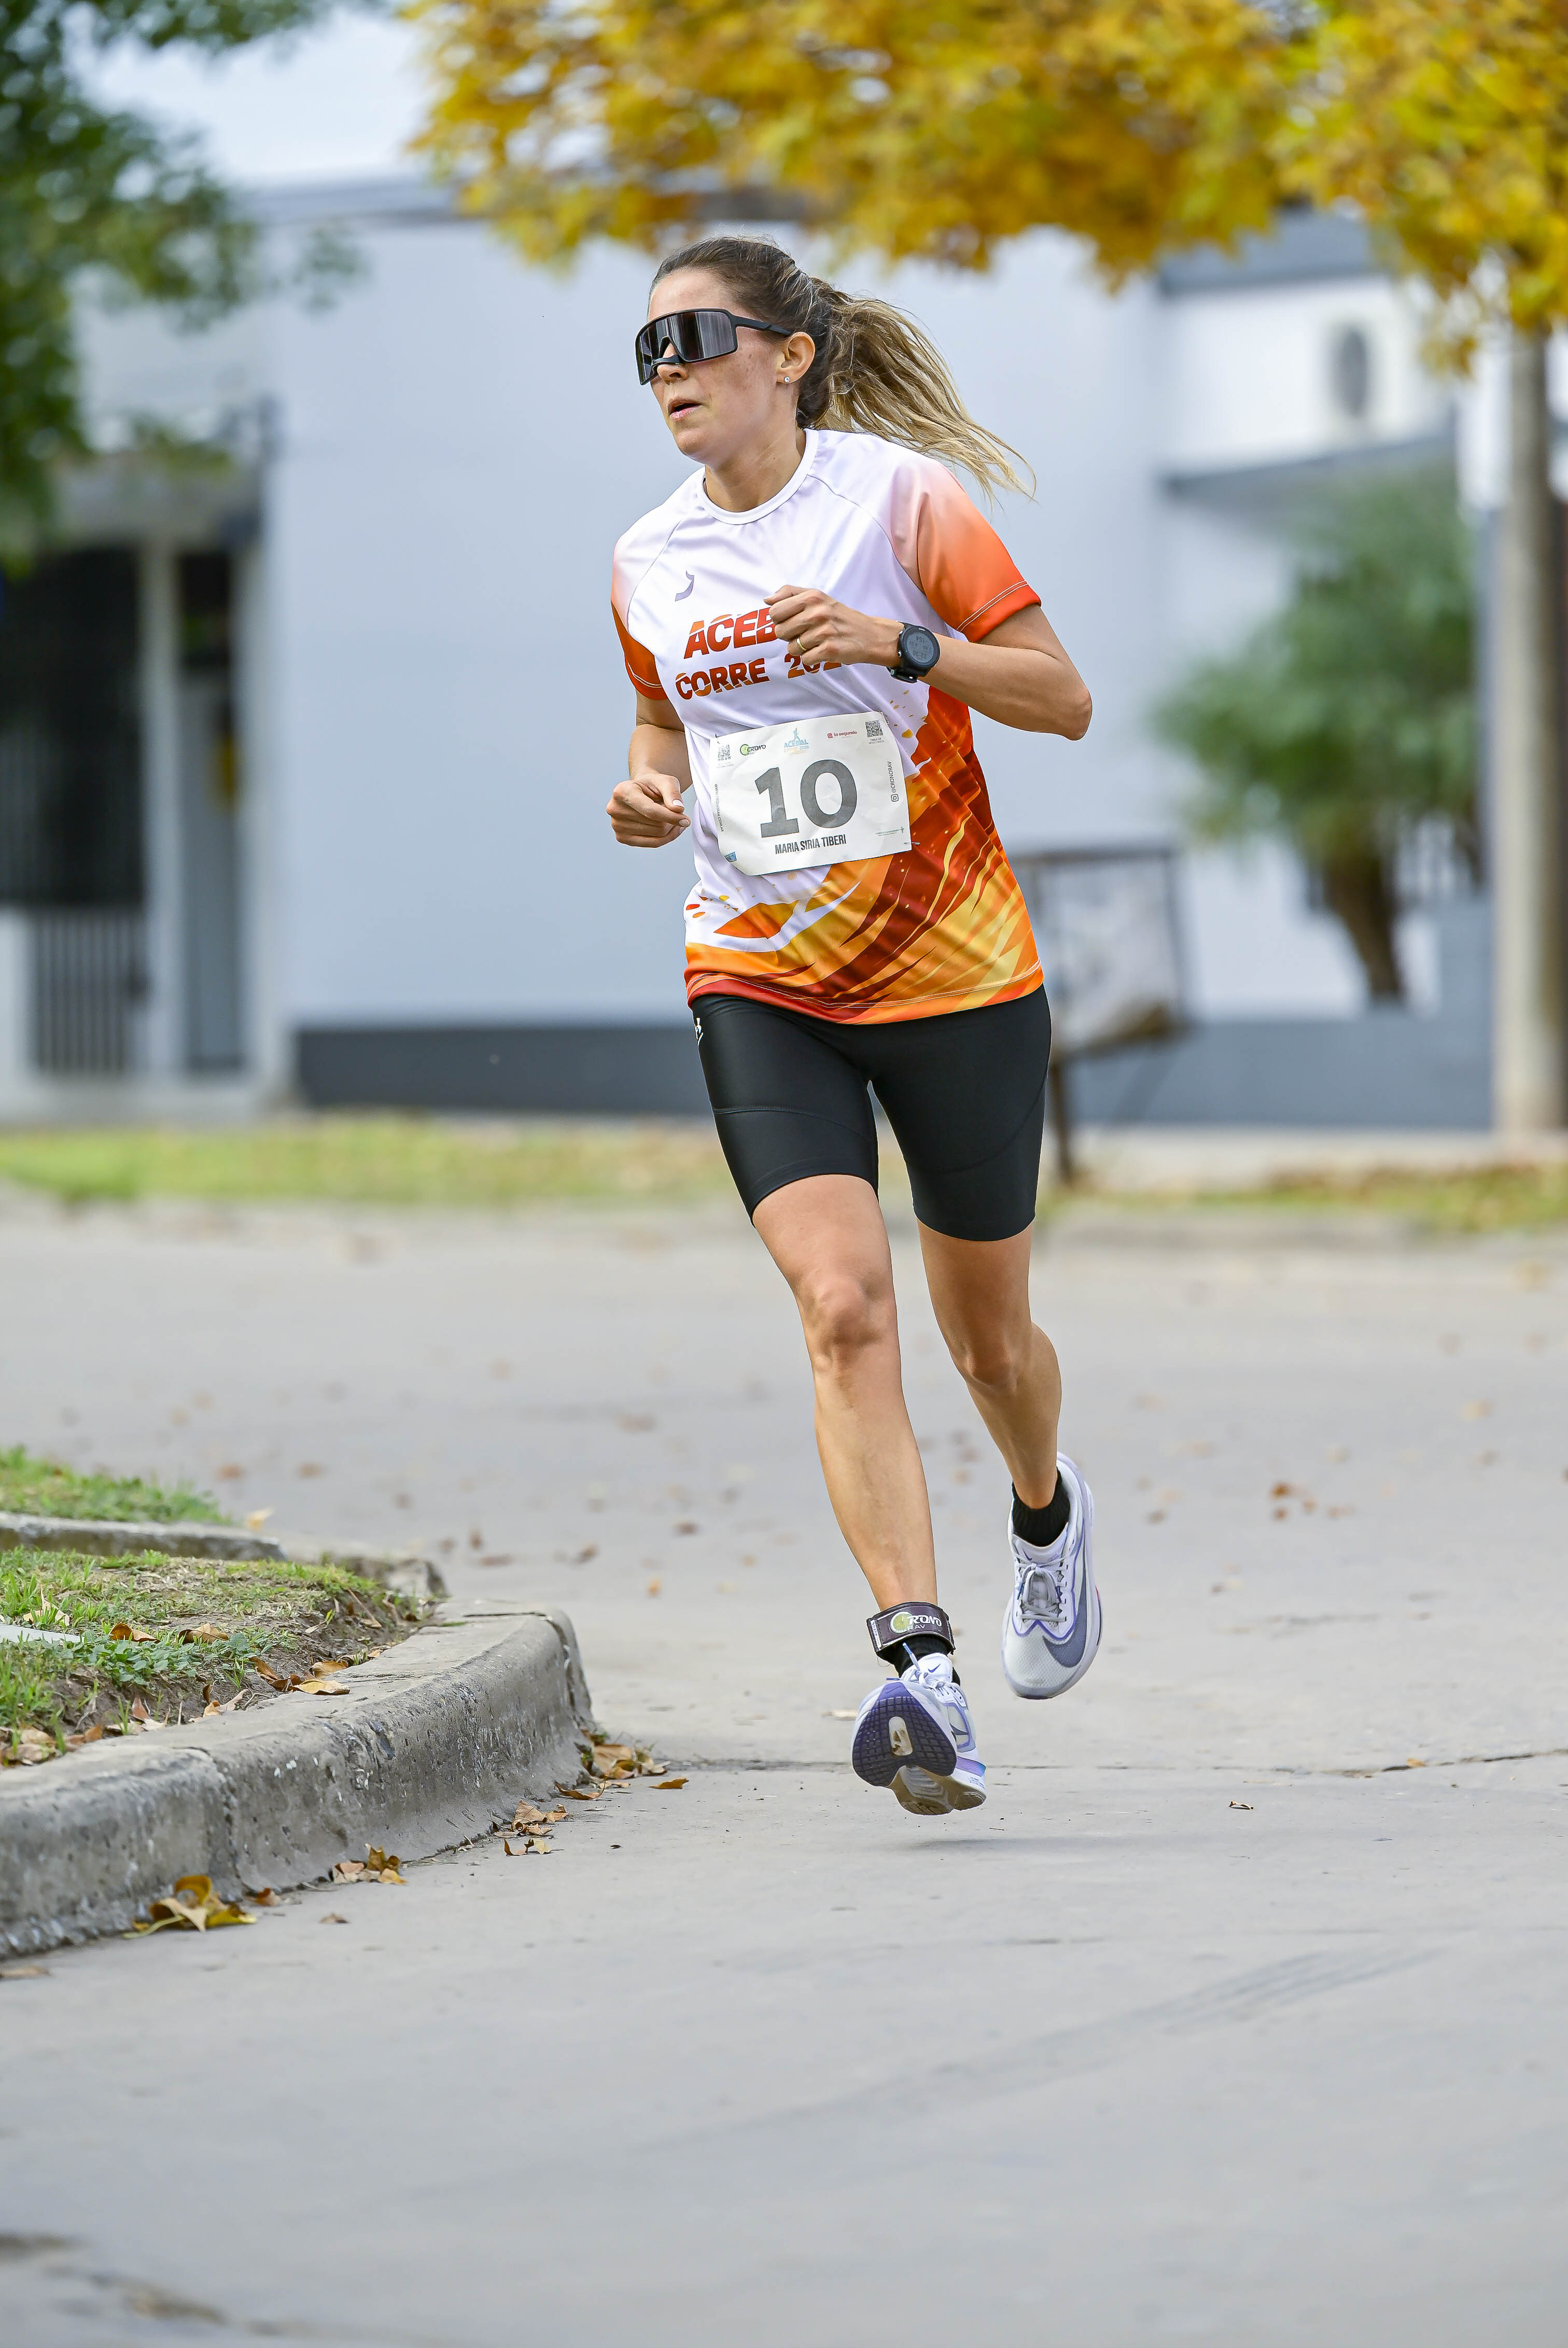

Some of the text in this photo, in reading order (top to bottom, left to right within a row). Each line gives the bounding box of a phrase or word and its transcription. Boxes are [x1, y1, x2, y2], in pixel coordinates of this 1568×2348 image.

[683, 607, 778, 659] ACEB
[675, 658, 771, 700] CORRE
[887, 761, 897, 793] @CRONORAV
[755, 759, 857, 838] 10
[775, 834, 847, 855] MARIA SIRIA TIBERI
